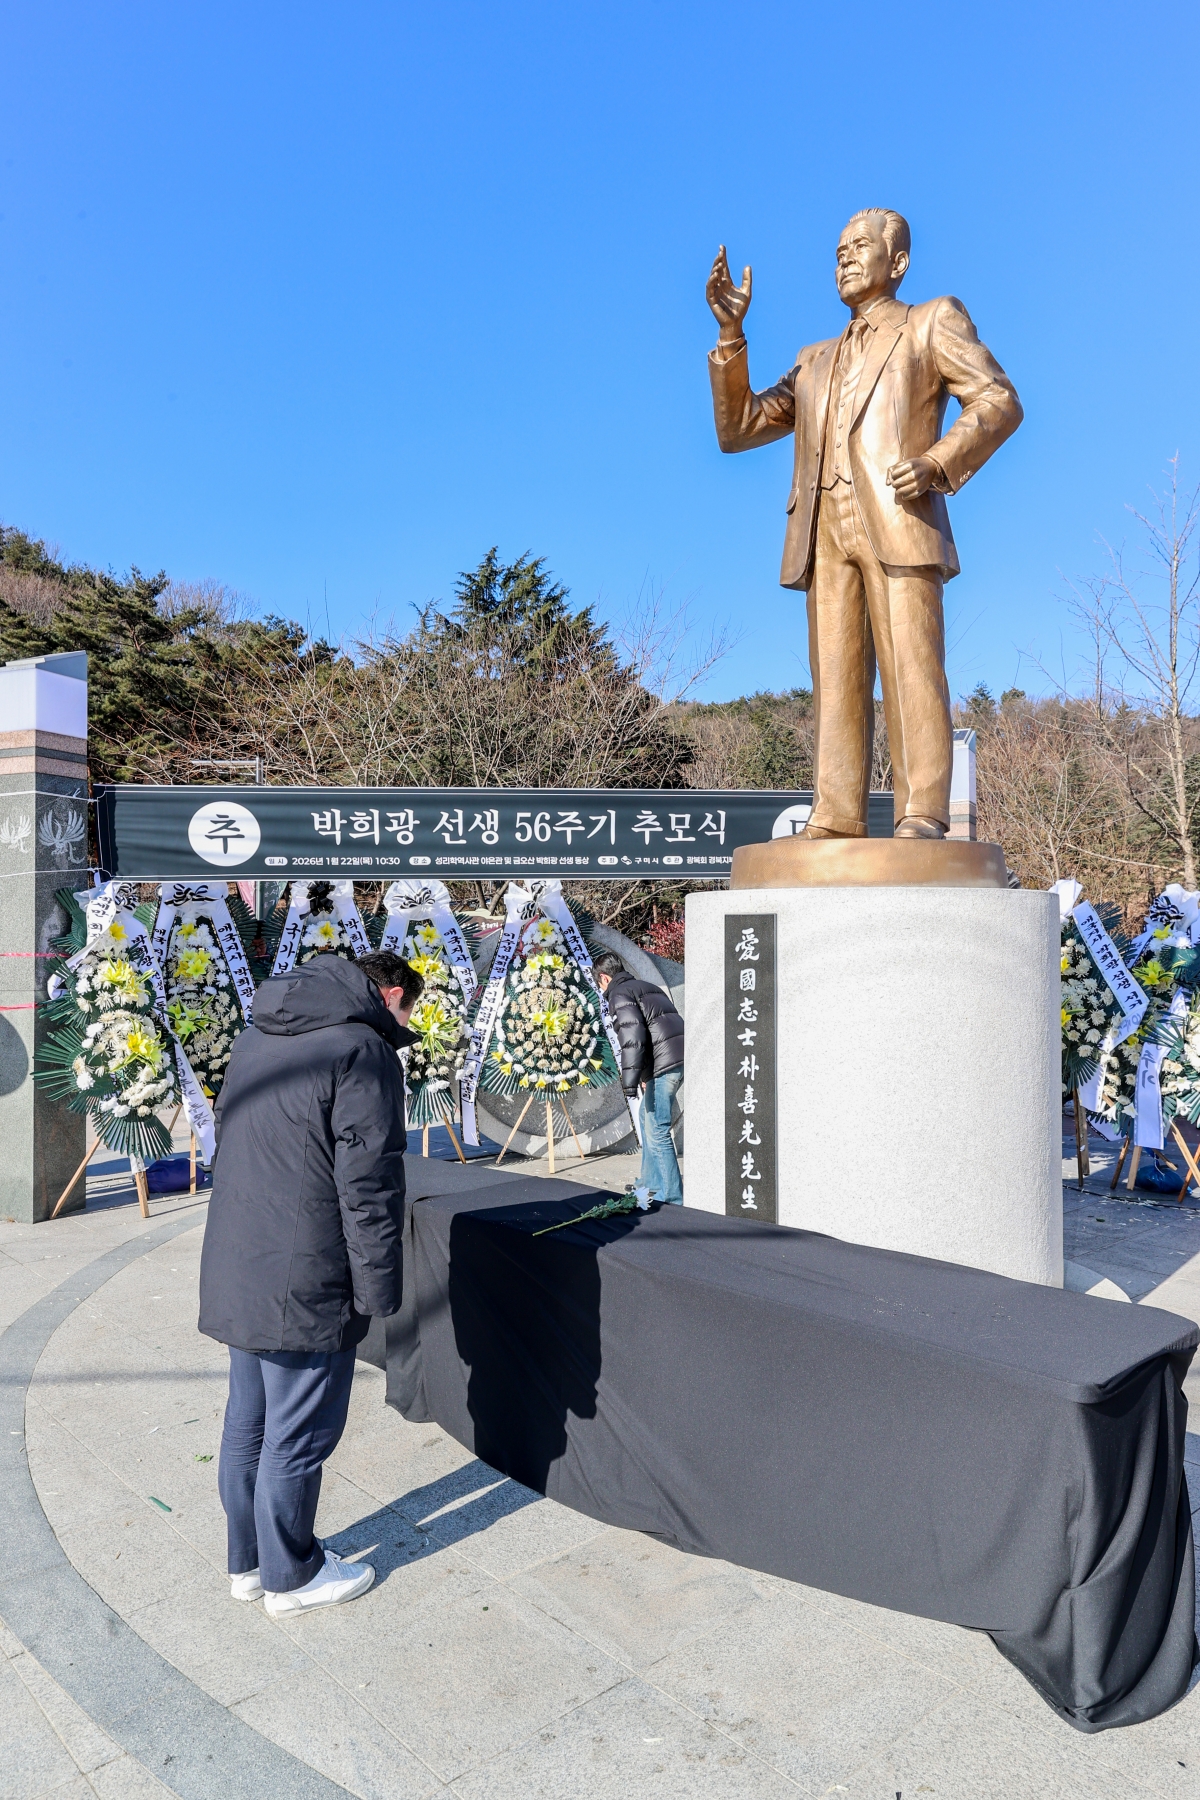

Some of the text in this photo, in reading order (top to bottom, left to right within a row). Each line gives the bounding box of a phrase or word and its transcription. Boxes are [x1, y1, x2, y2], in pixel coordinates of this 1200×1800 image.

[204, 813, 245, 855] 추
[311, 809, 726, 846] 박희광 선생 56주기 추모식
[291, 856, 401, 866] 2026년 1월 22일(목) 10:30
[435, 856, 590, 866] 성리학역사관 야은관 및 금오산 박희광 선생 동상
[686, 856, 708, 865] 광복회
[217, 922, 246, 962] 애국지사
[233, 966, 255, 998] 박희광
[443, 926, 470, 963] 애국지사
[563, 926, 590, 963] 애국지사
[1111, 970, 1131, 990] 선생
[734, 927, 762, 1210] 愛國志士朴喜光先生
